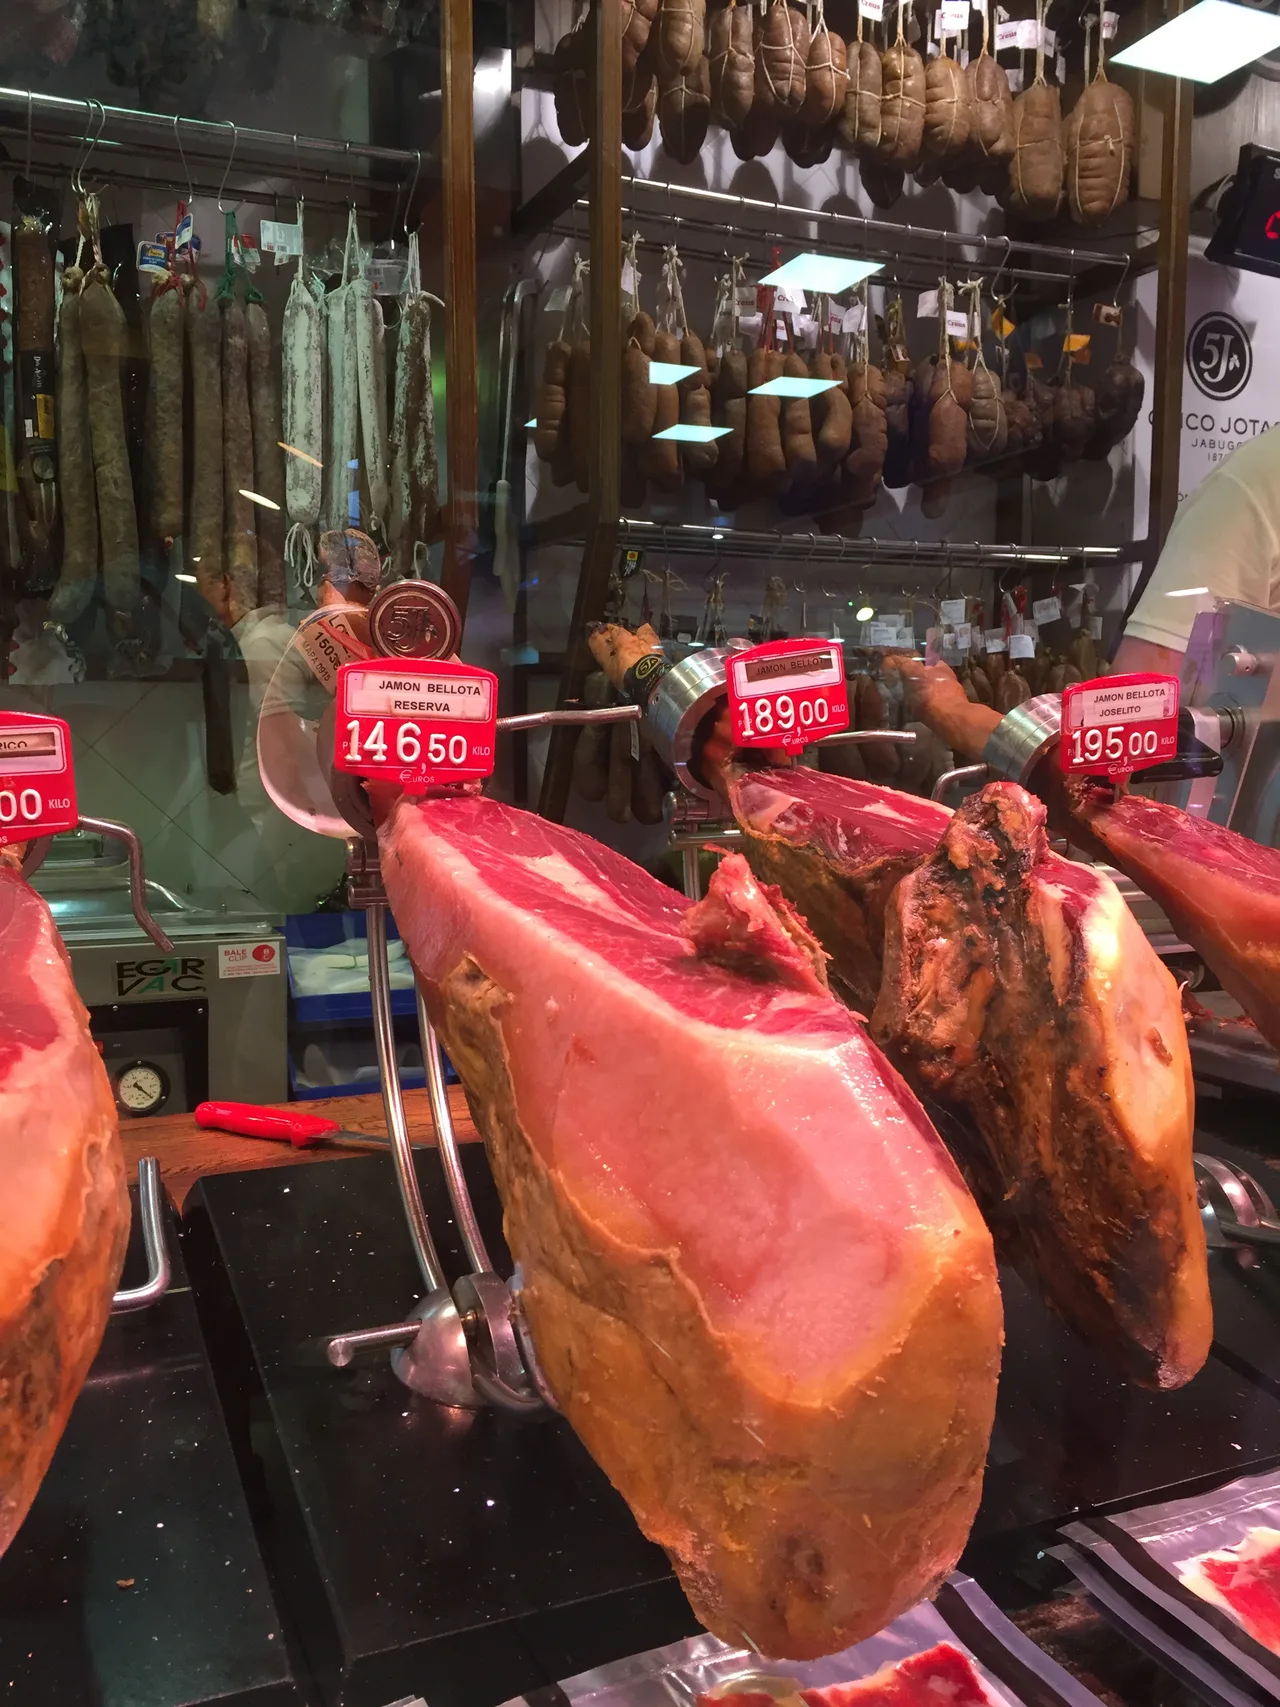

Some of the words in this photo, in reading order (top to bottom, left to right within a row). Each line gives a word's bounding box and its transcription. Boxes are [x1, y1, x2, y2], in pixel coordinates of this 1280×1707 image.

[1199, 332, 1235, 383] 5J
[1207, 453, 1228, 461] 187
[756, 663, 786, 676] JAMON
[379, 681, 421, 692] JAMON
[427, 683, 481, 696] BELLOTA
[1094, 692, 1124, 704] JAMON
[1126, 688, 1166, 700] BELLOTA
[394, 700, 450, 712] RESERVA
[831, 703, 846, 713] KILO
[1099, 705, 1142, 718] JOSELITO
[1160, 736, 1175, 745] KILO
[472, 746, 491, 756] KILO
[48, 798, 71, 809] KILO
[224, 948, 247, 956] BALE
[116, 958, 206, 979] EGAR
[117, 975, 206, 996] VAC
